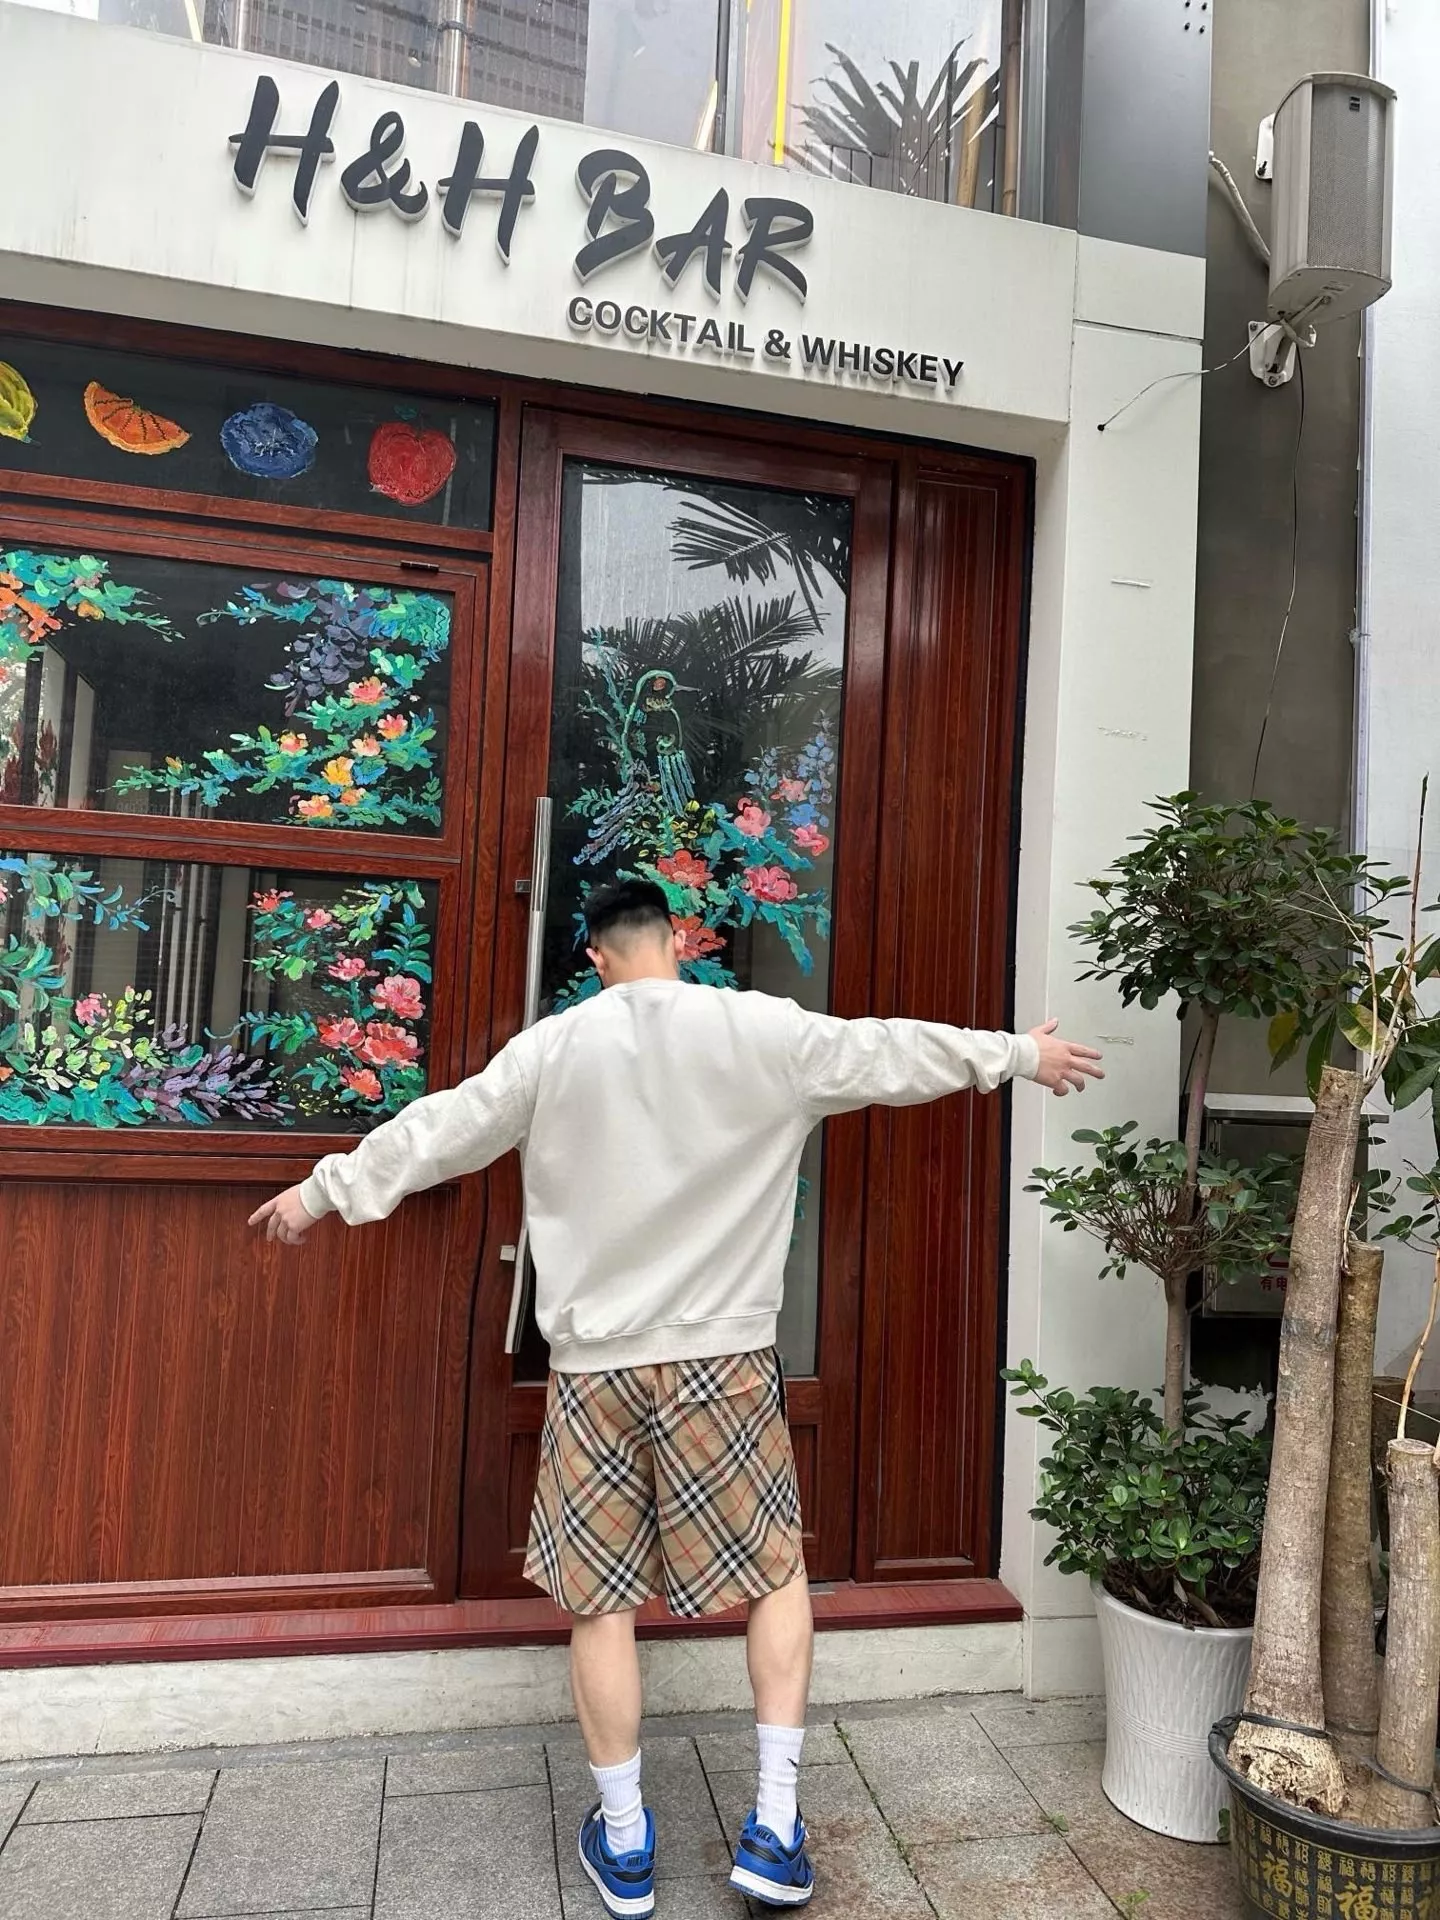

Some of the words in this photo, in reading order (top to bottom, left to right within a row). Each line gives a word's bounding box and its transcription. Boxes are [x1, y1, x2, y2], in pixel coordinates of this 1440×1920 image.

[228, 75, 541, 264] H&H
[573, 149, 814, 304] BAR
[567, 296, 756, 357] COCKTAIL
[763, 329, 792, 364] &
[800, 333, 965, 391] WHISKEY
[753, 1826, 773, 1843] NIKE
